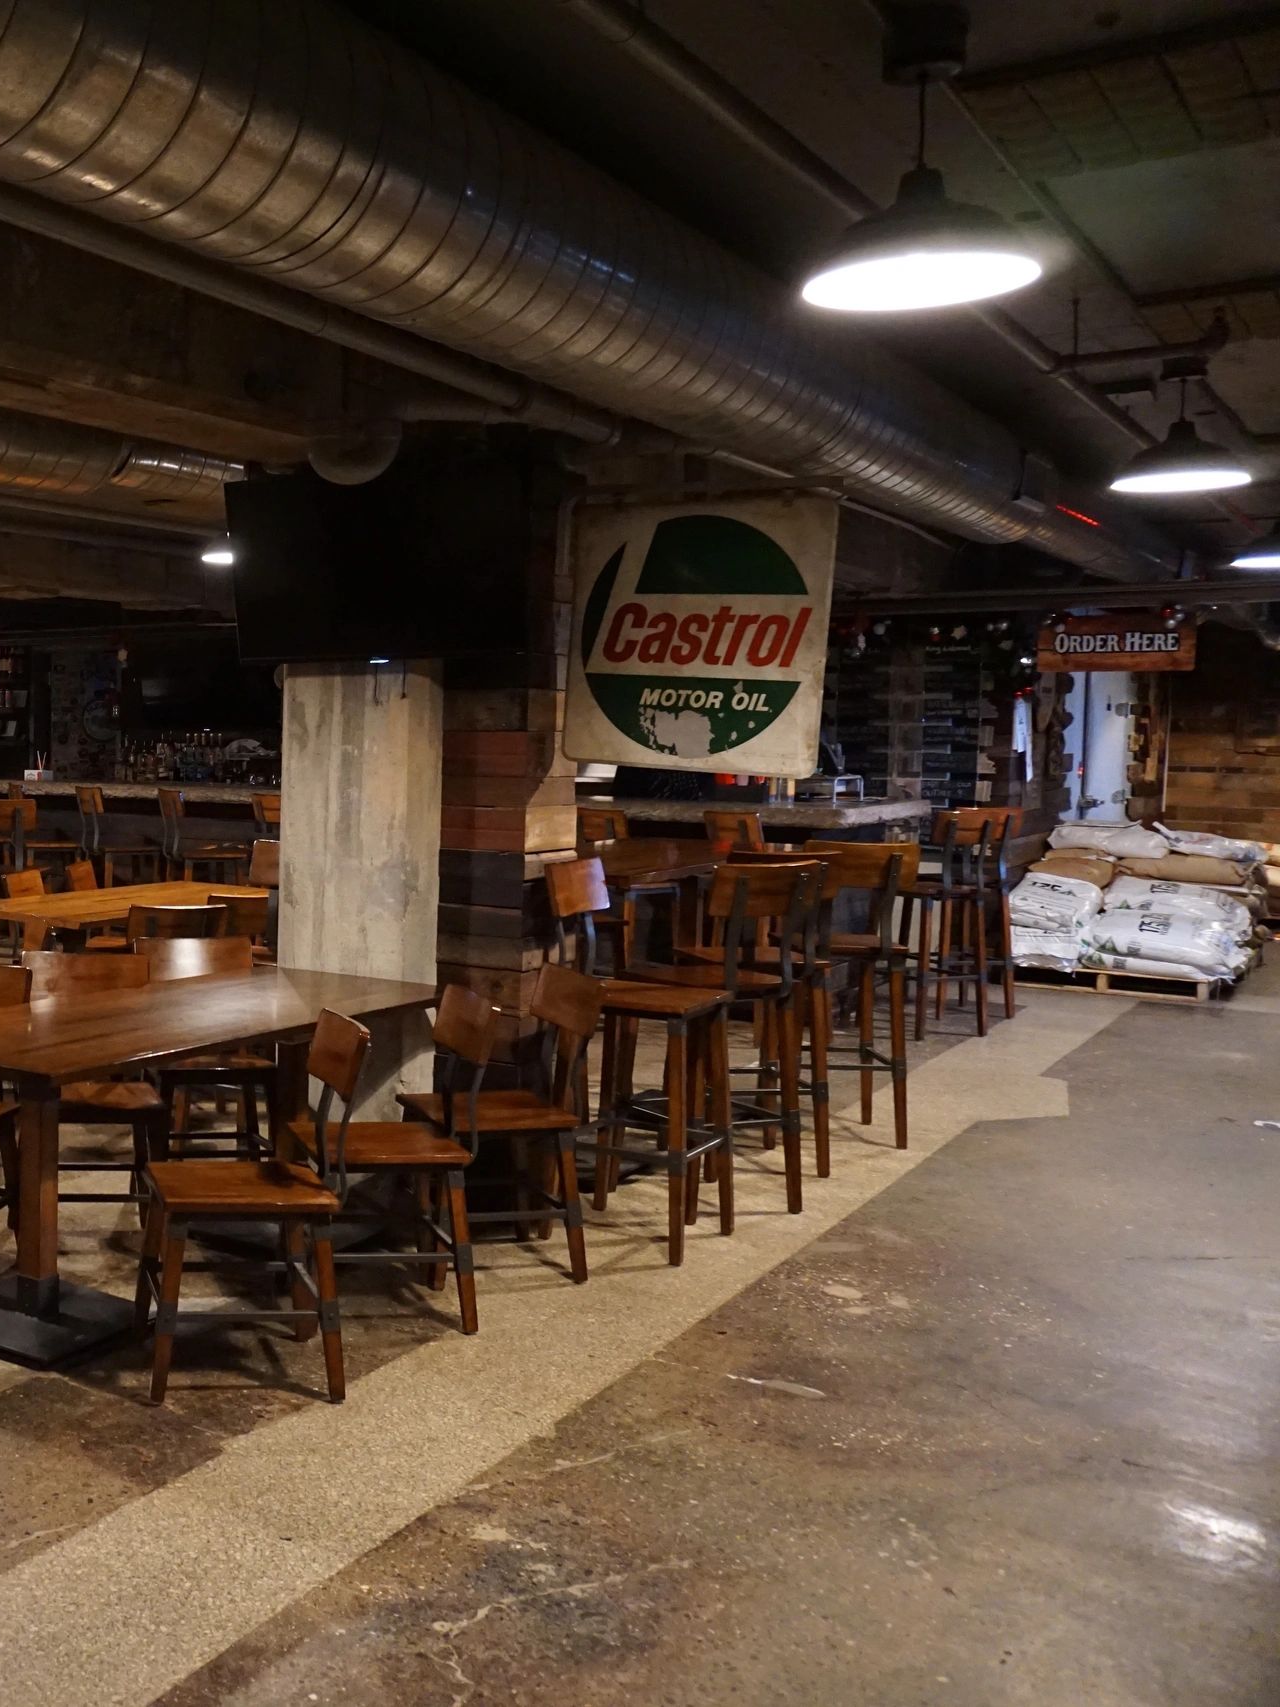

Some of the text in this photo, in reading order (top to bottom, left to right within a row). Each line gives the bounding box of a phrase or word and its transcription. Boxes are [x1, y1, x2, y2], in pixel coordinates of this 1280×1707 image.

[603, 602, 813, 667] Castrol
[1054, 631, 1180, 654] ORDER HERE
[639, 687, 770, 712] MOTOR OIL
